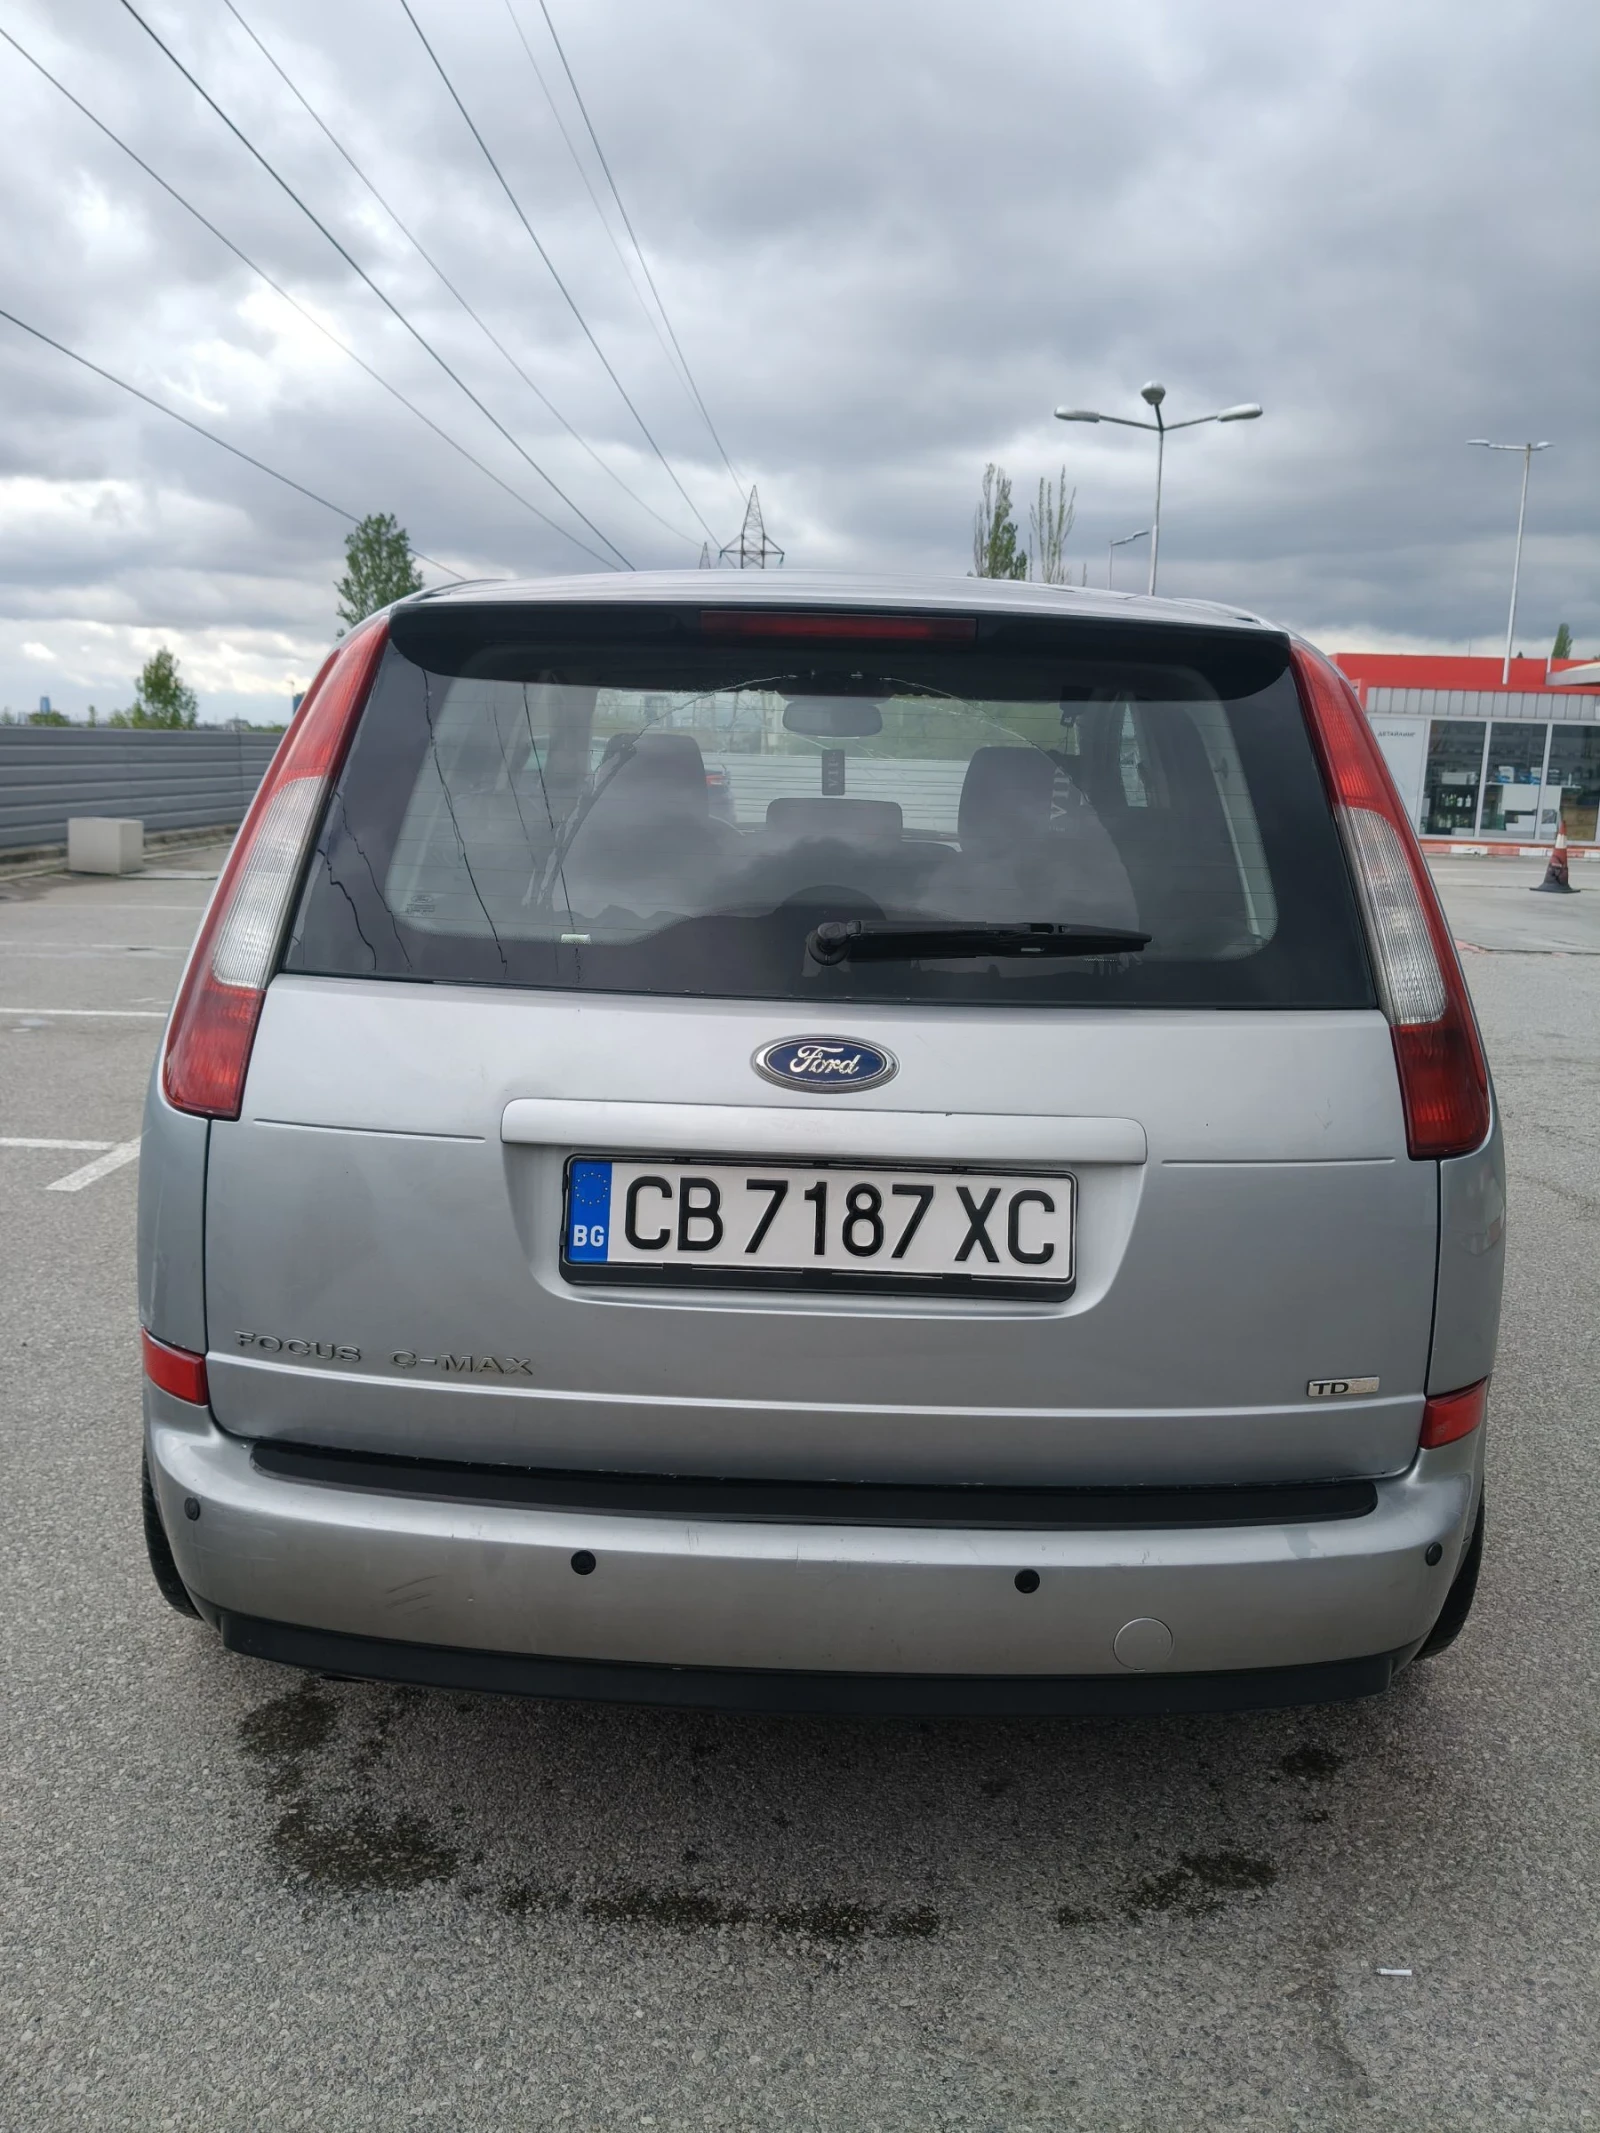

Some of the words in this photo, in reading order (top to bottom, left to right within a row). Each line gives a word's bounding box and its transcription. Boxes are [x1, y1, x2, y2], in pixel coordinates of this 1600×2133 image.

[789, 1045, 862, 1075] Ford
[625, 1175, 724, 1251] CB
[744, 1179, 935, 1259] 7187
[954, 1187, 1056, 1265] XC
[573, 1224, 605, 1247] BG
[233, 1330, 362, 1363] FOCUS
[389, 1349, 534, 1376] C-MAX
[1312, 1382, 1349, 1395] TD
